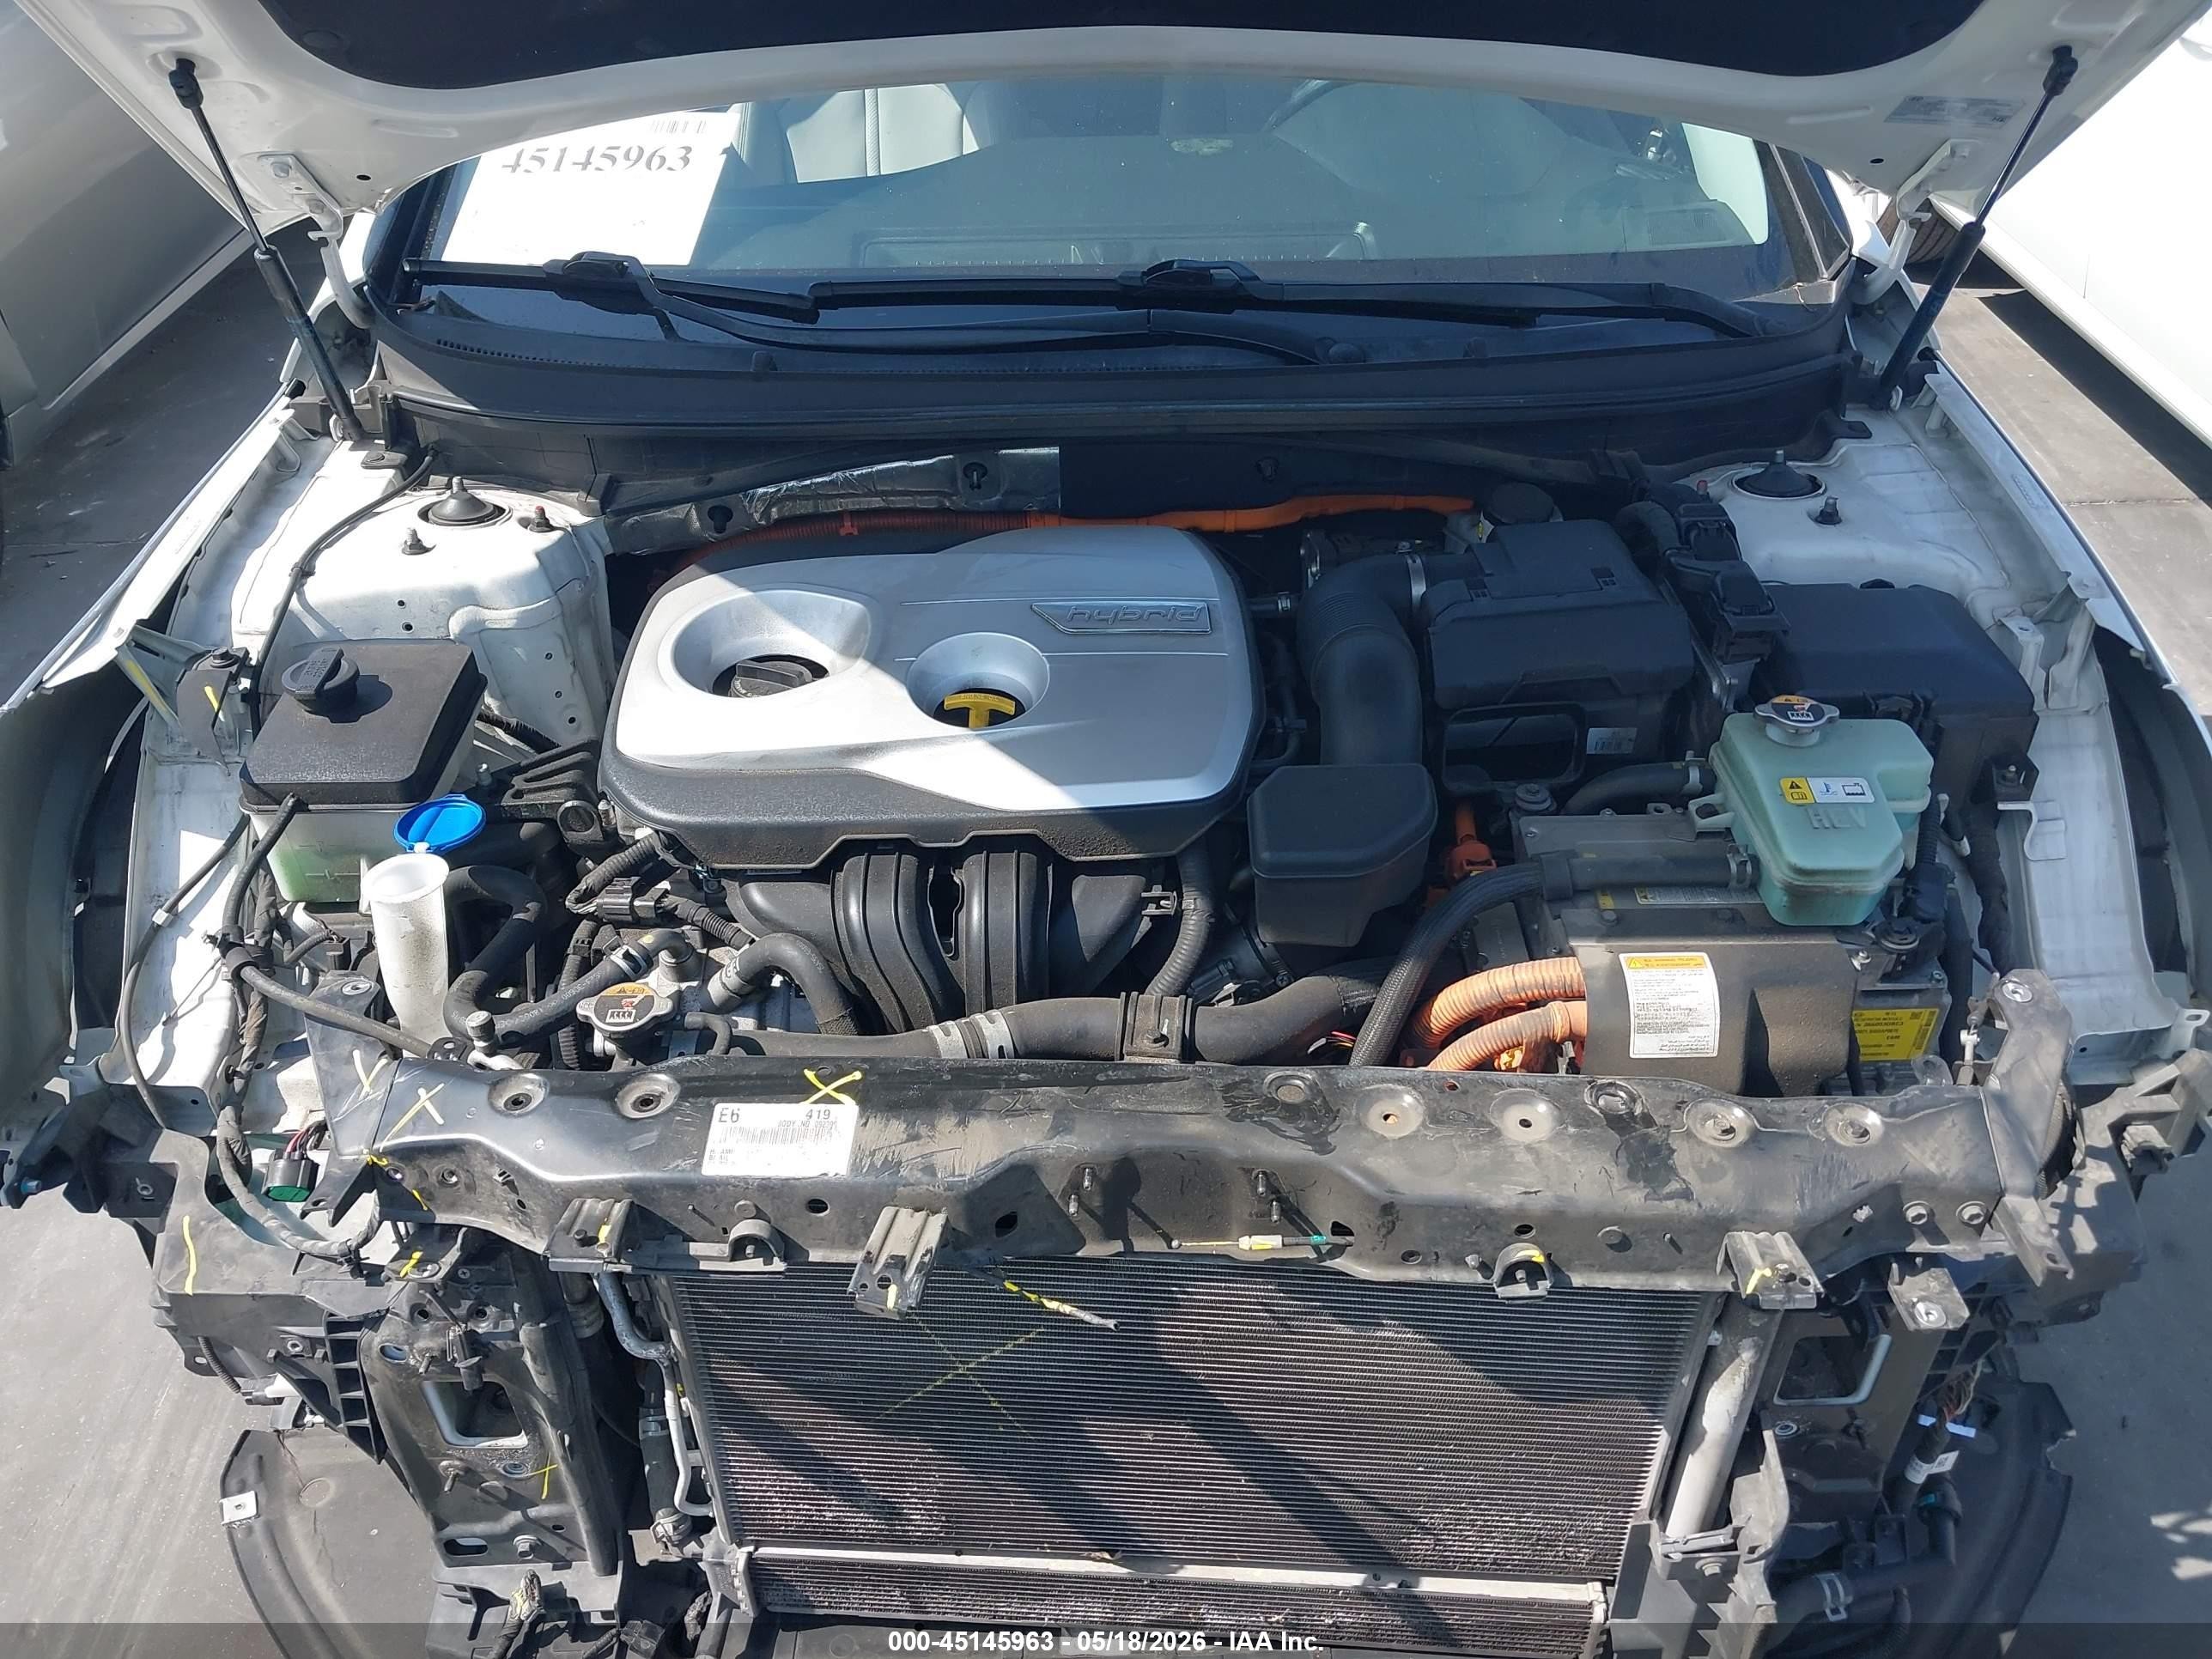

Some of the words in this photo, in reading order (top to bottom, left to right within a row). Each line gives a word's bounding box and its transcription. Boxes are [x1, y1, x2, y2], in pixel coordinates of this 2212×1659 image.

[501, 143, 692, 174] 45145963
[1066, 605, 1202, 625] hybrid
[1806, 806, 1868, 830] HEV
[805, 1108, 831, 1121] 419
